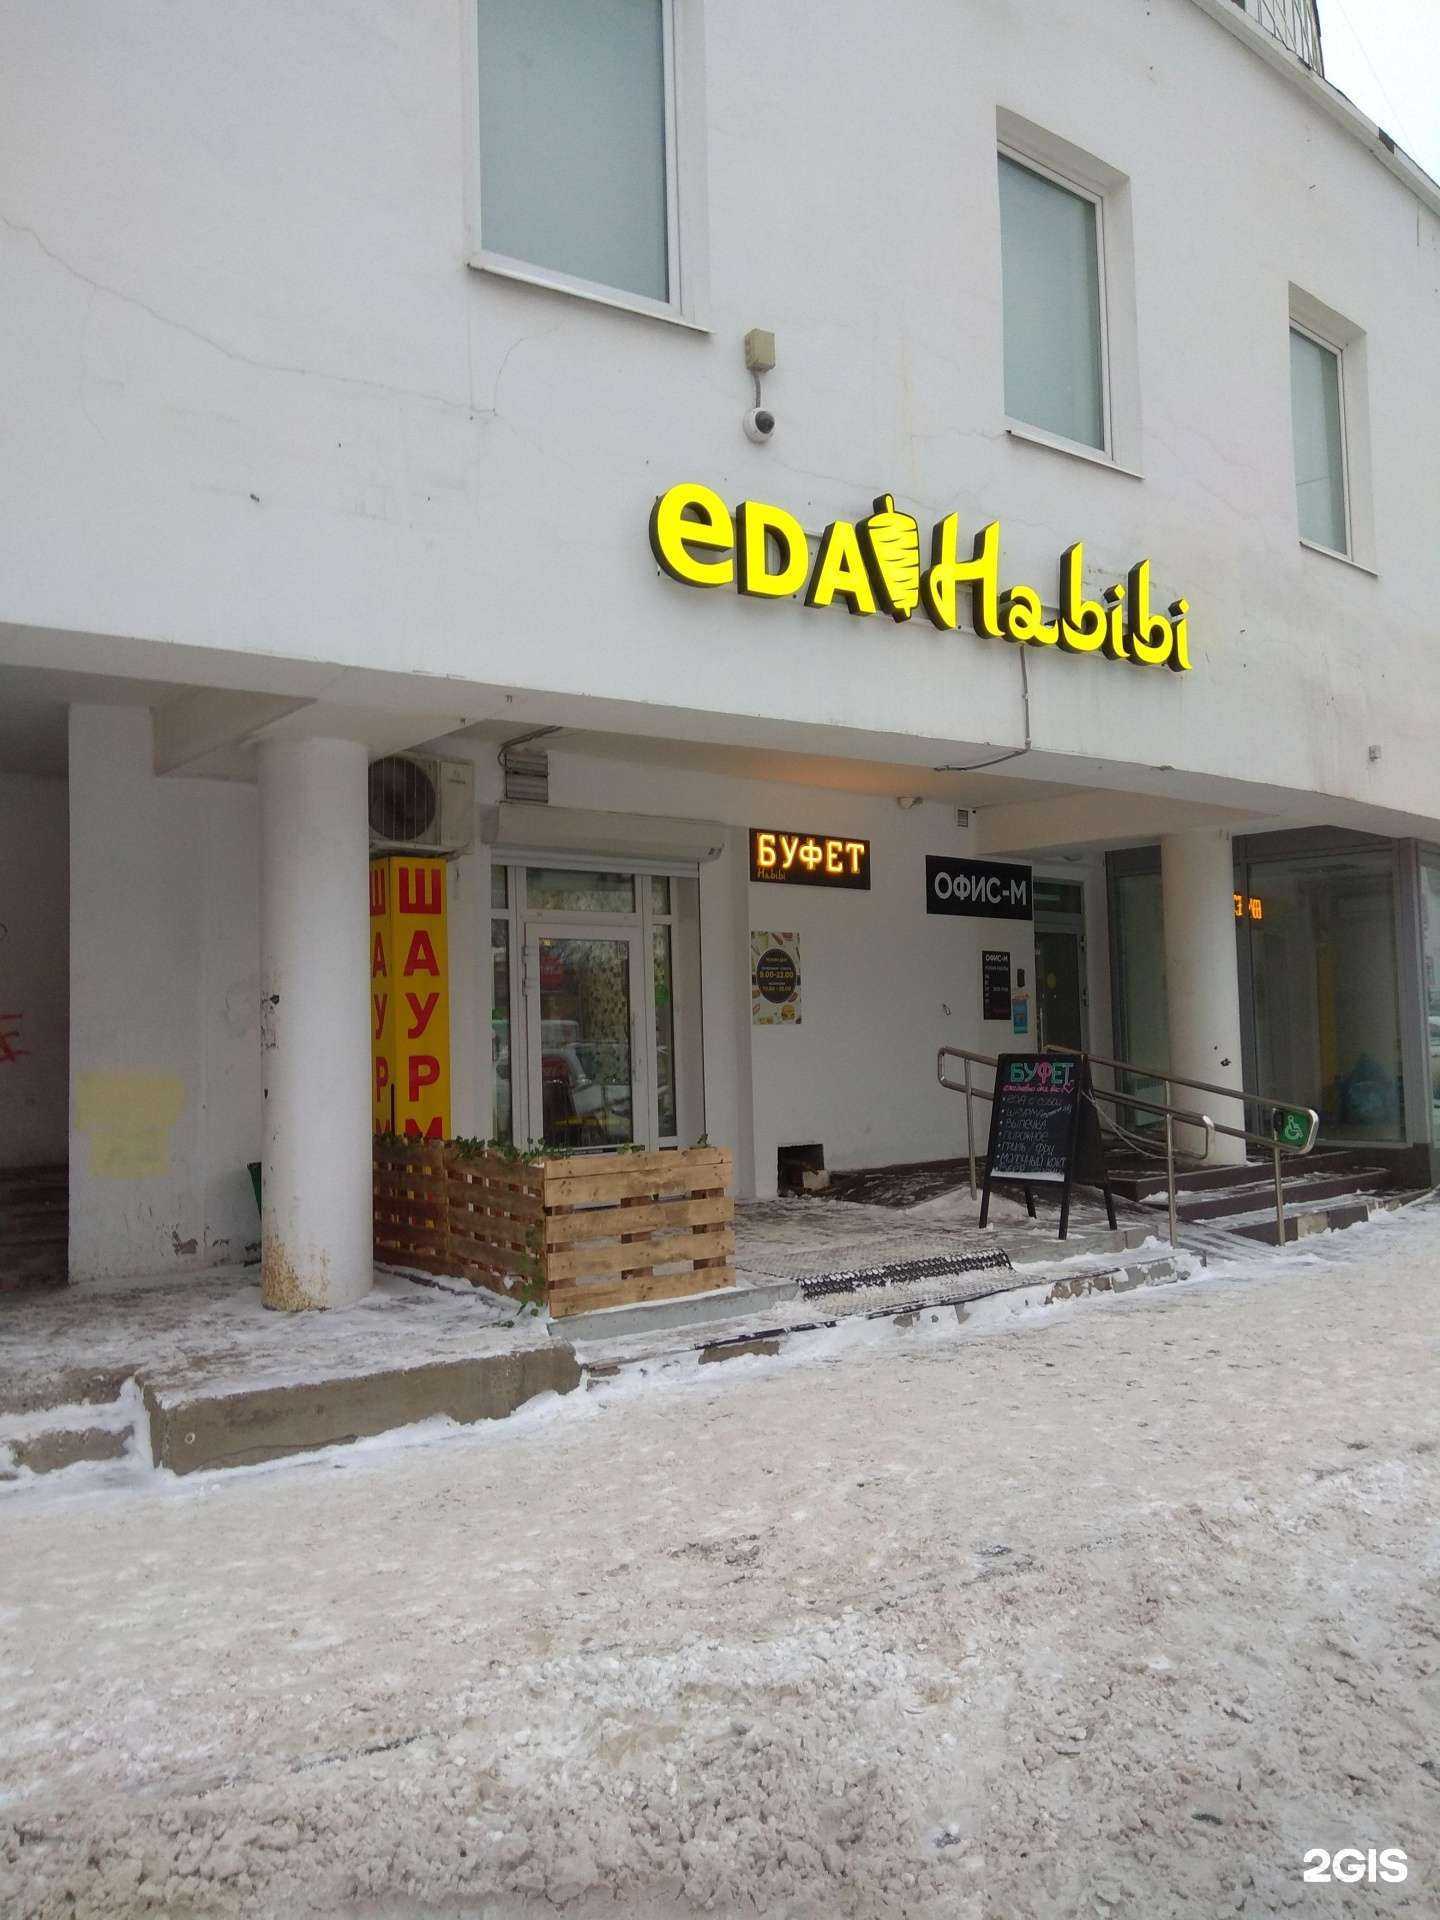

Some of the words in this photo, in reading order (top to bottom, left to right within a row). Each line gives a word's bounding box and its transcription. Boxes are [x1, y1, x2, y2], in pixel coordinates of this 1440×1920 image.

[920, 511, 1193, 672] Habibi
[756, 832, 866, 874] БУФЕТ
[934, 871, 1027, 907] ОФИС-М
[1010, 1061, 1074, 1085] БУФЕТ
